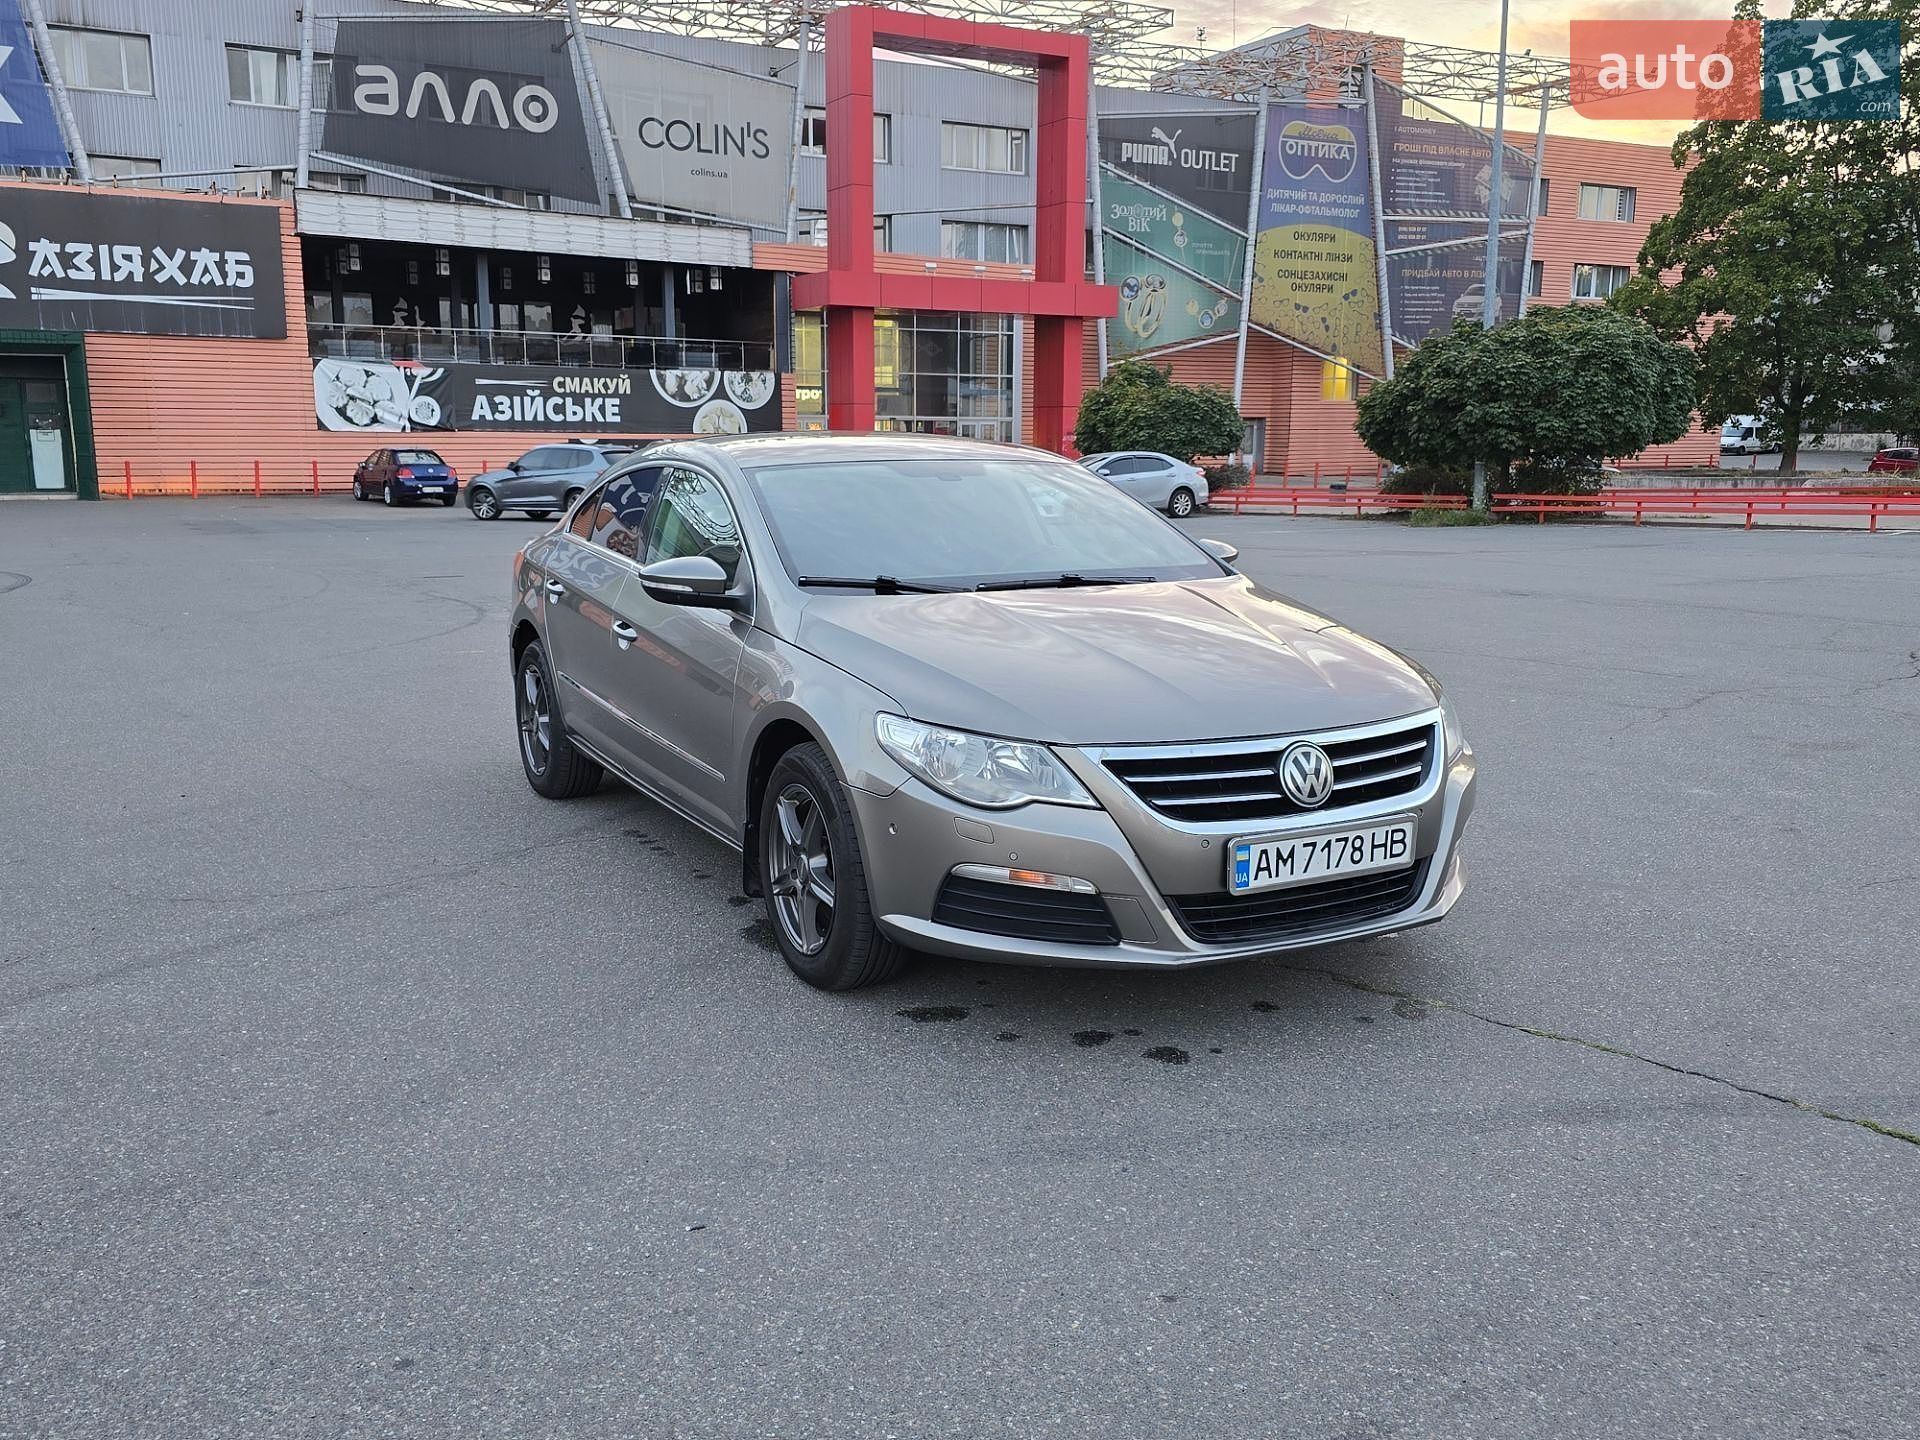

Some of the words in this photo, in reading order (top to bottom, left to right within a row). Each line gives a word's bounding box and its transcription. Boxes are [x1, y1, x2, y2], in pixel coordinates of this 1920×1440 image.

[639, 117, 770, 159] COLIN'S
[1121, 142, 1169, 166] PUMA
[1181, 149, 1239, 172] OUTLET
[1285, 141, 1350, 160] ОПТИКА
[1393, 142, 1421, 153] ГРОШІ
[1422, 145, 1438, 155] ПІД
[1438, 146, 1470, 157] ВЛАСНЕ
[1471, 148, 1492, 158] АВТО
[690, 167, 728, 179] colins.ua
[1266, 188, 1307, 201] ДИТЯЧИЙ
[1308, 191, 1317, 201] ТА
[1319, 192, 1365, 205] ДОРОСЛИЙ
[1270, 203, 1360, 218] ЛІКАР-ОФТАЛЬМОЛОГ
[1293, 231, 1336, 243] ОКУЛЯРИ
[28, 238, 144, 282] АЗІЯ
[150, 246, 255, 288] ХАБ
[1273, 249, 1323, 261] КОНТАКТНІ
[1325, 252, 1353, 263] ЛІНЗИ
[1277, 269, 1348, 282] СОНЦЕЗАХИСНІ
[1401, 268, 1440, 279] ПРИДБАЙ
[1291, 282, 1334, 293] ОКУЛЯРИ
[552, 374, 631, 395] СМАКУЙ
[471, 389, 621, 422] АЗІЙСЬКЕ
[1254, 845, 1295, 881] AM
[1302, 835, 1364, 873] 7178
[1370, 828, 1407, 862] HB
[1235, 873, 1248, 884] UA
